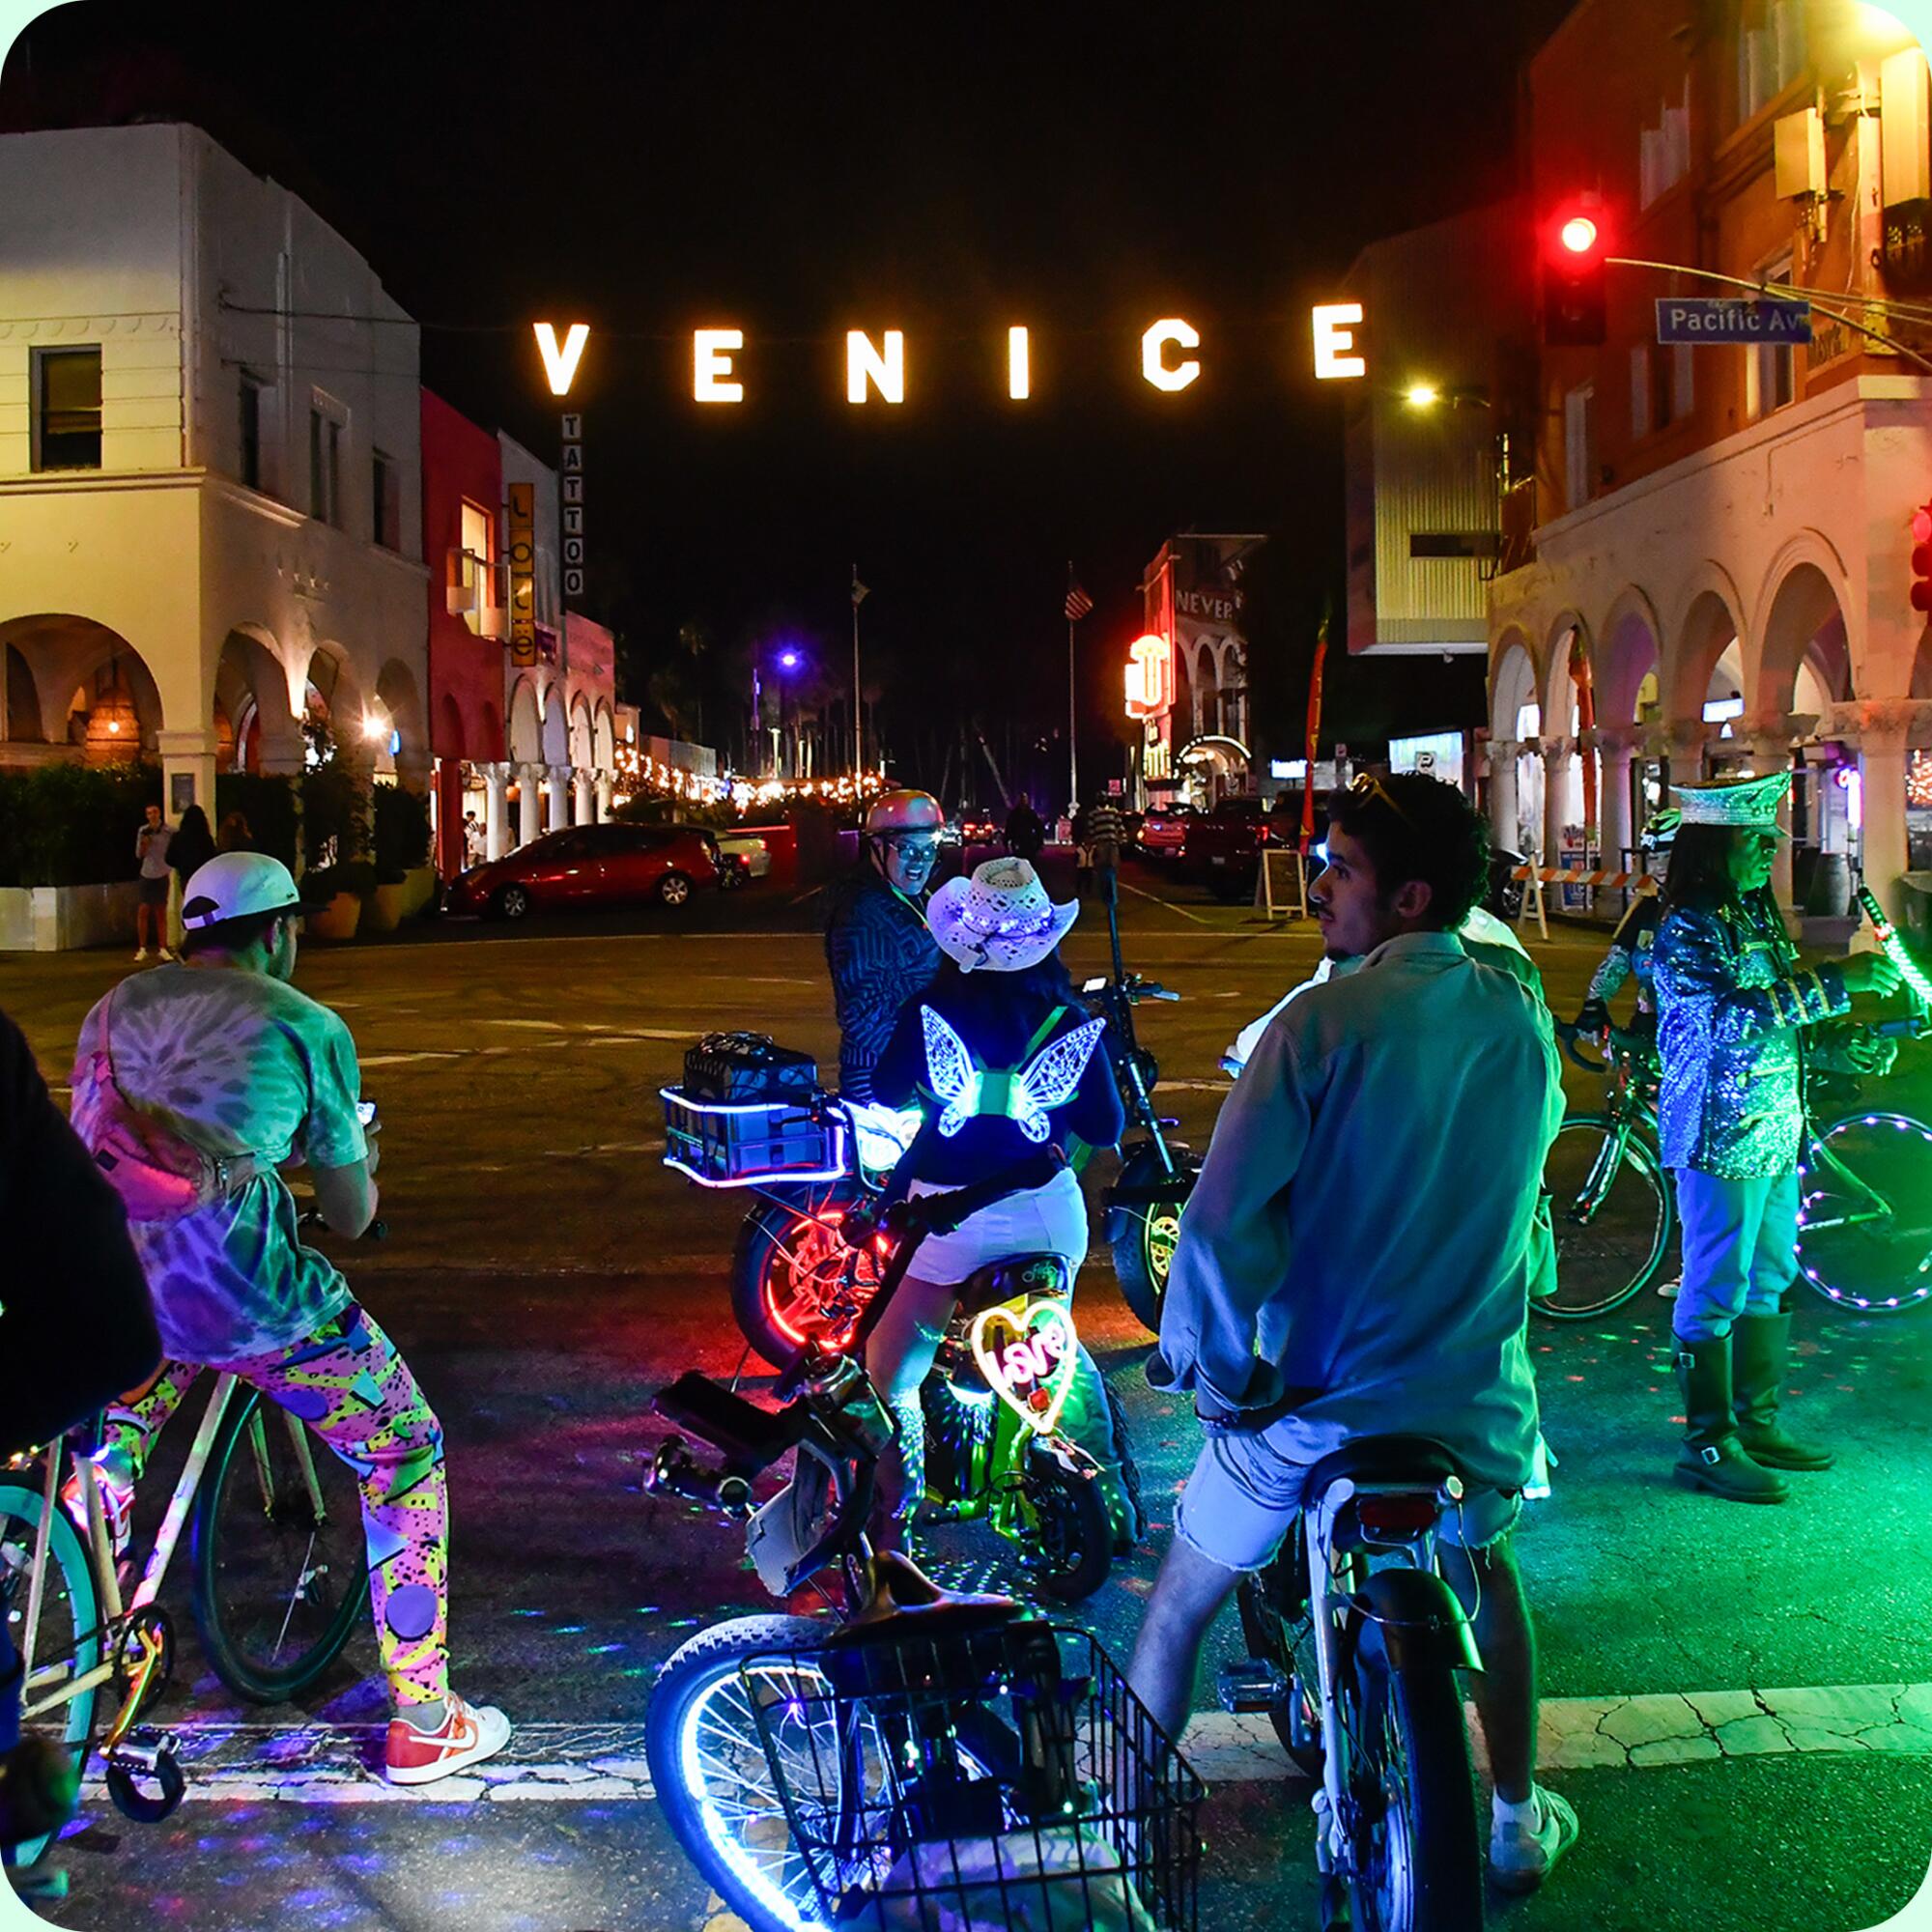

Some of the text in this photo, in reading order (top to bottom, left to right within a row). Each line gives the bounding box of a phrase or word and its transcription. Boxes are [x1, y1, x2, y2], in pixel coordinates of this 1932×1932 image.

[532, 302, 1367, 404] VENICE
[1670, 308, 1761, 331] Pacific
[564, 416, 581, 592] TATTOO
